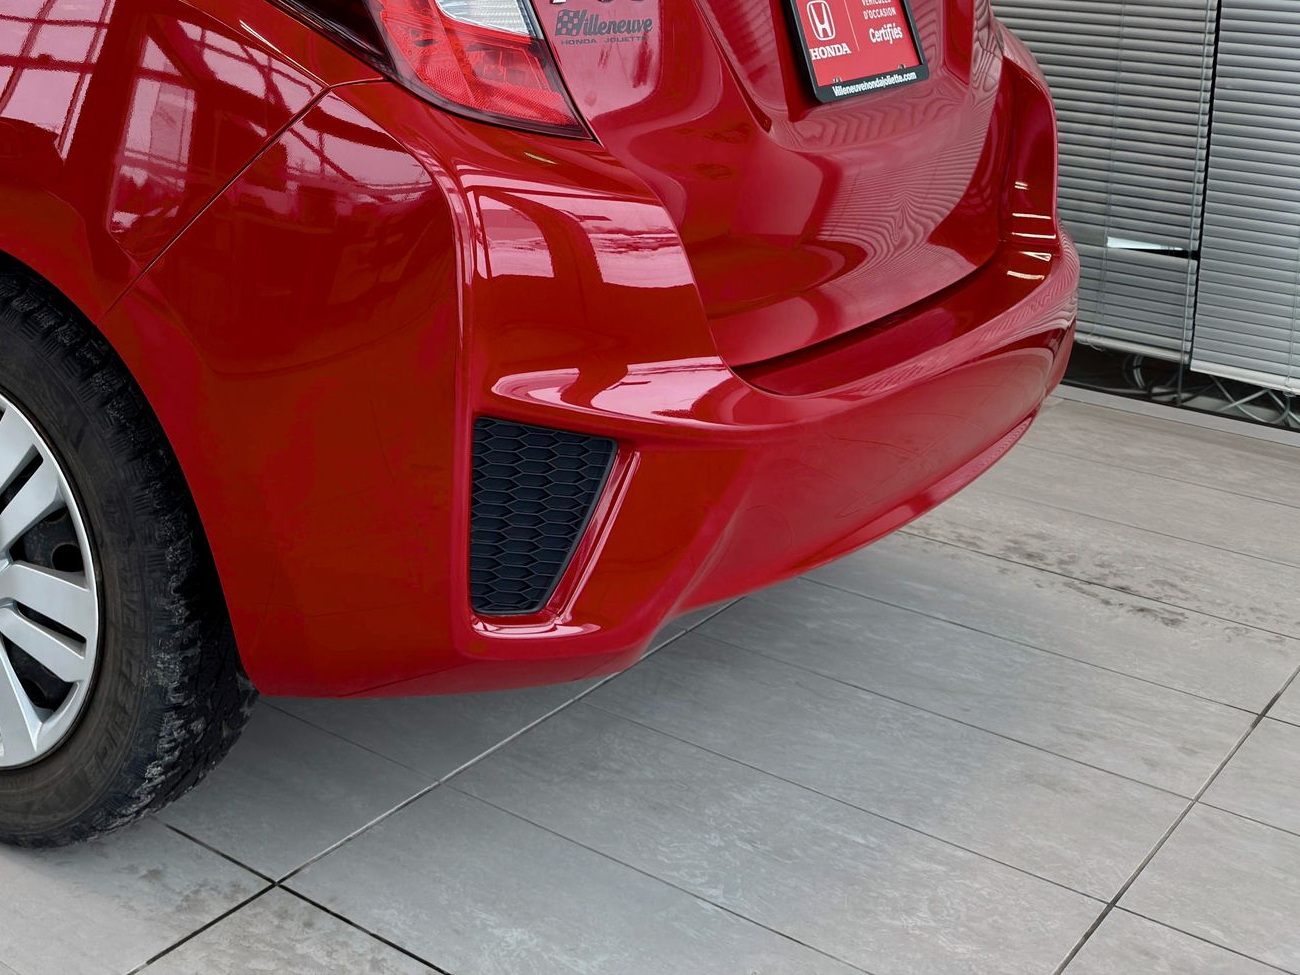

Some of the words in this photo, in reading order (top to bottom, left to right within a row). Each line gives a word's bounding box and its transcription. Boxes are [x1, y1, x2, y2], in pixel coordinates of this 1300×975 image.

[555, 9, 653, 37] Villeneuve
[869, 22, 903, 44] Certifiés
[604, 35, 649, 43] JOLIETTE
[809, 42, 852, 61] HONDA
[832, 72, 917, 96] Villeneuvehondajoliette.com
